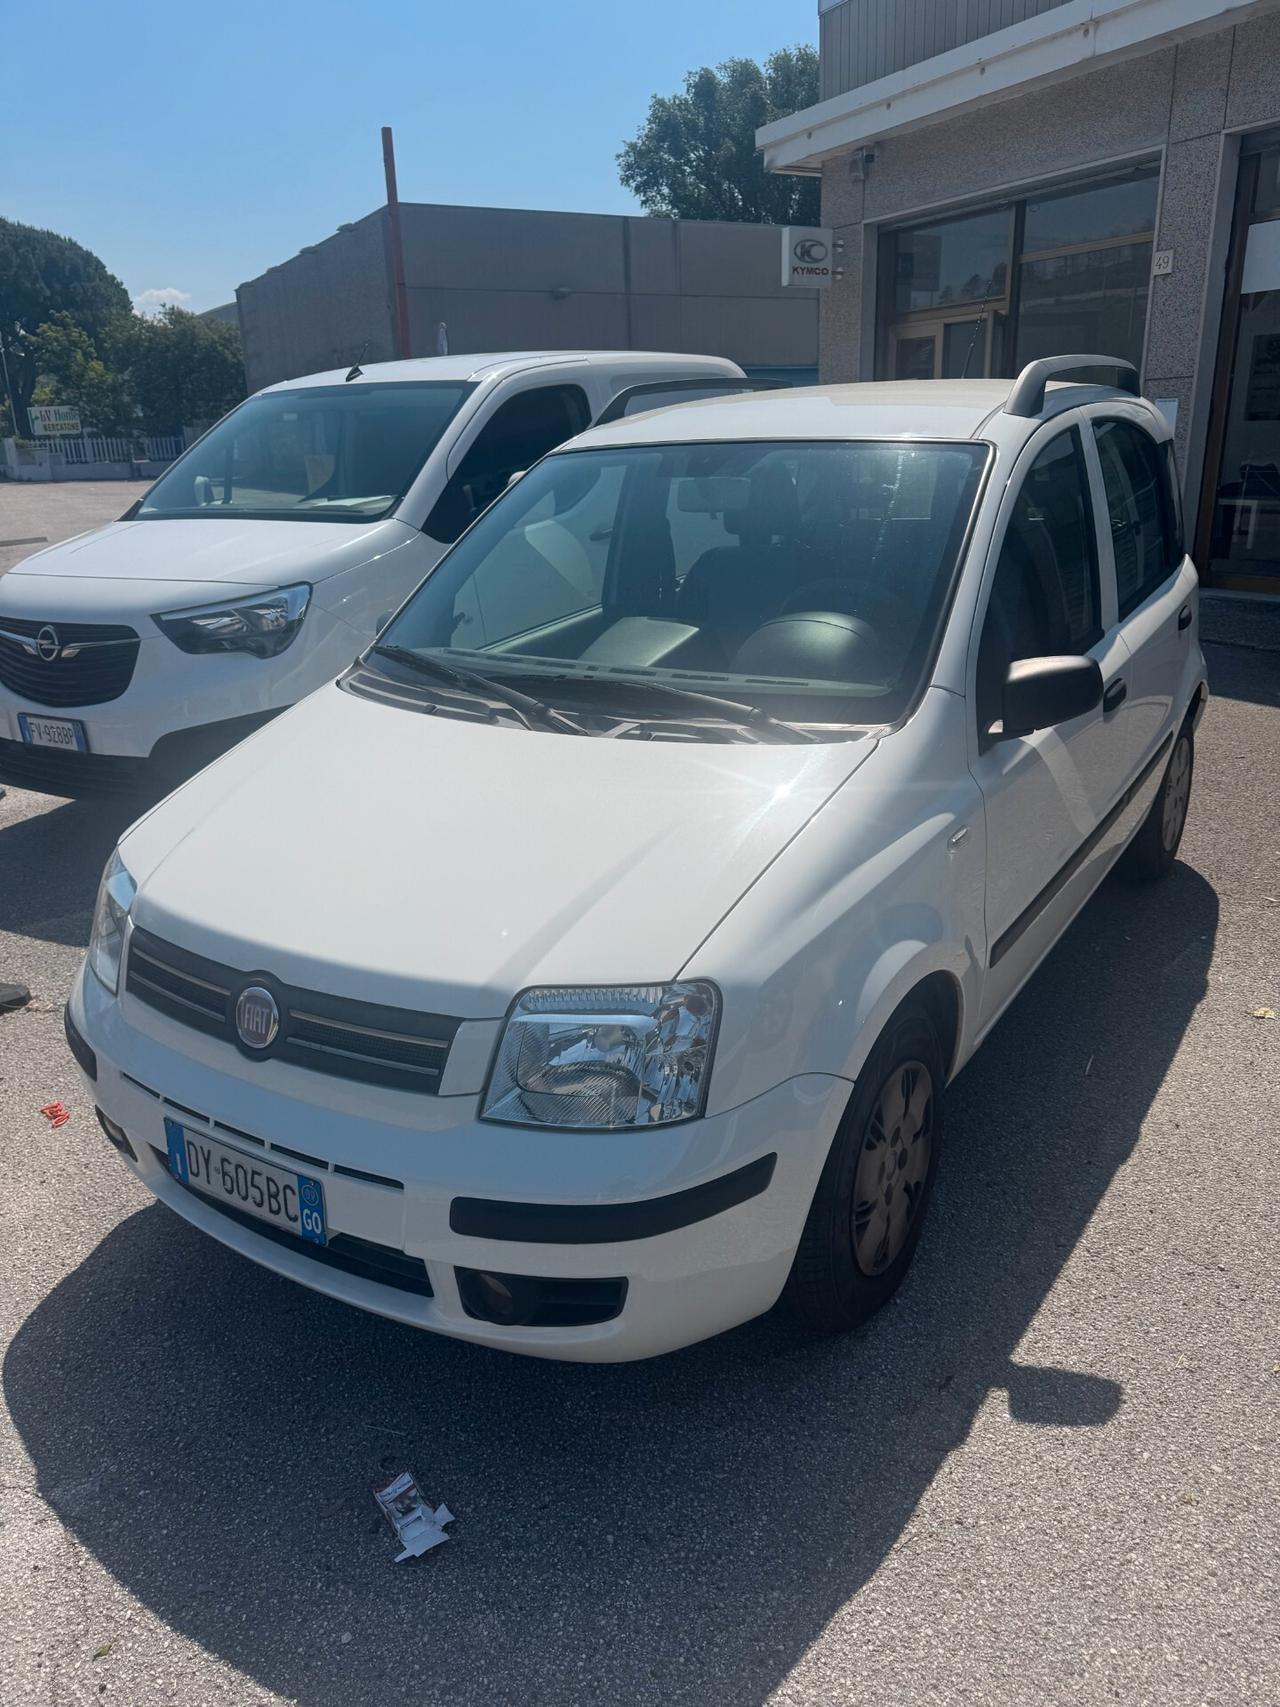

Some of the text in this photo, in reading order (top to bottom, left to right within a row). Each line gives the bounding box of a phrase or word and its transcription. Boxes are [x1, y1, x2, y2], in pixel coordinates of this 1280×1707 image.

[792, 266, 829, 276] KYMCO
[1155, 255, 1170, 270] 49
[244, 1003, 270, 1034] FIAT
[302, 1208, 322, 1234] GO
